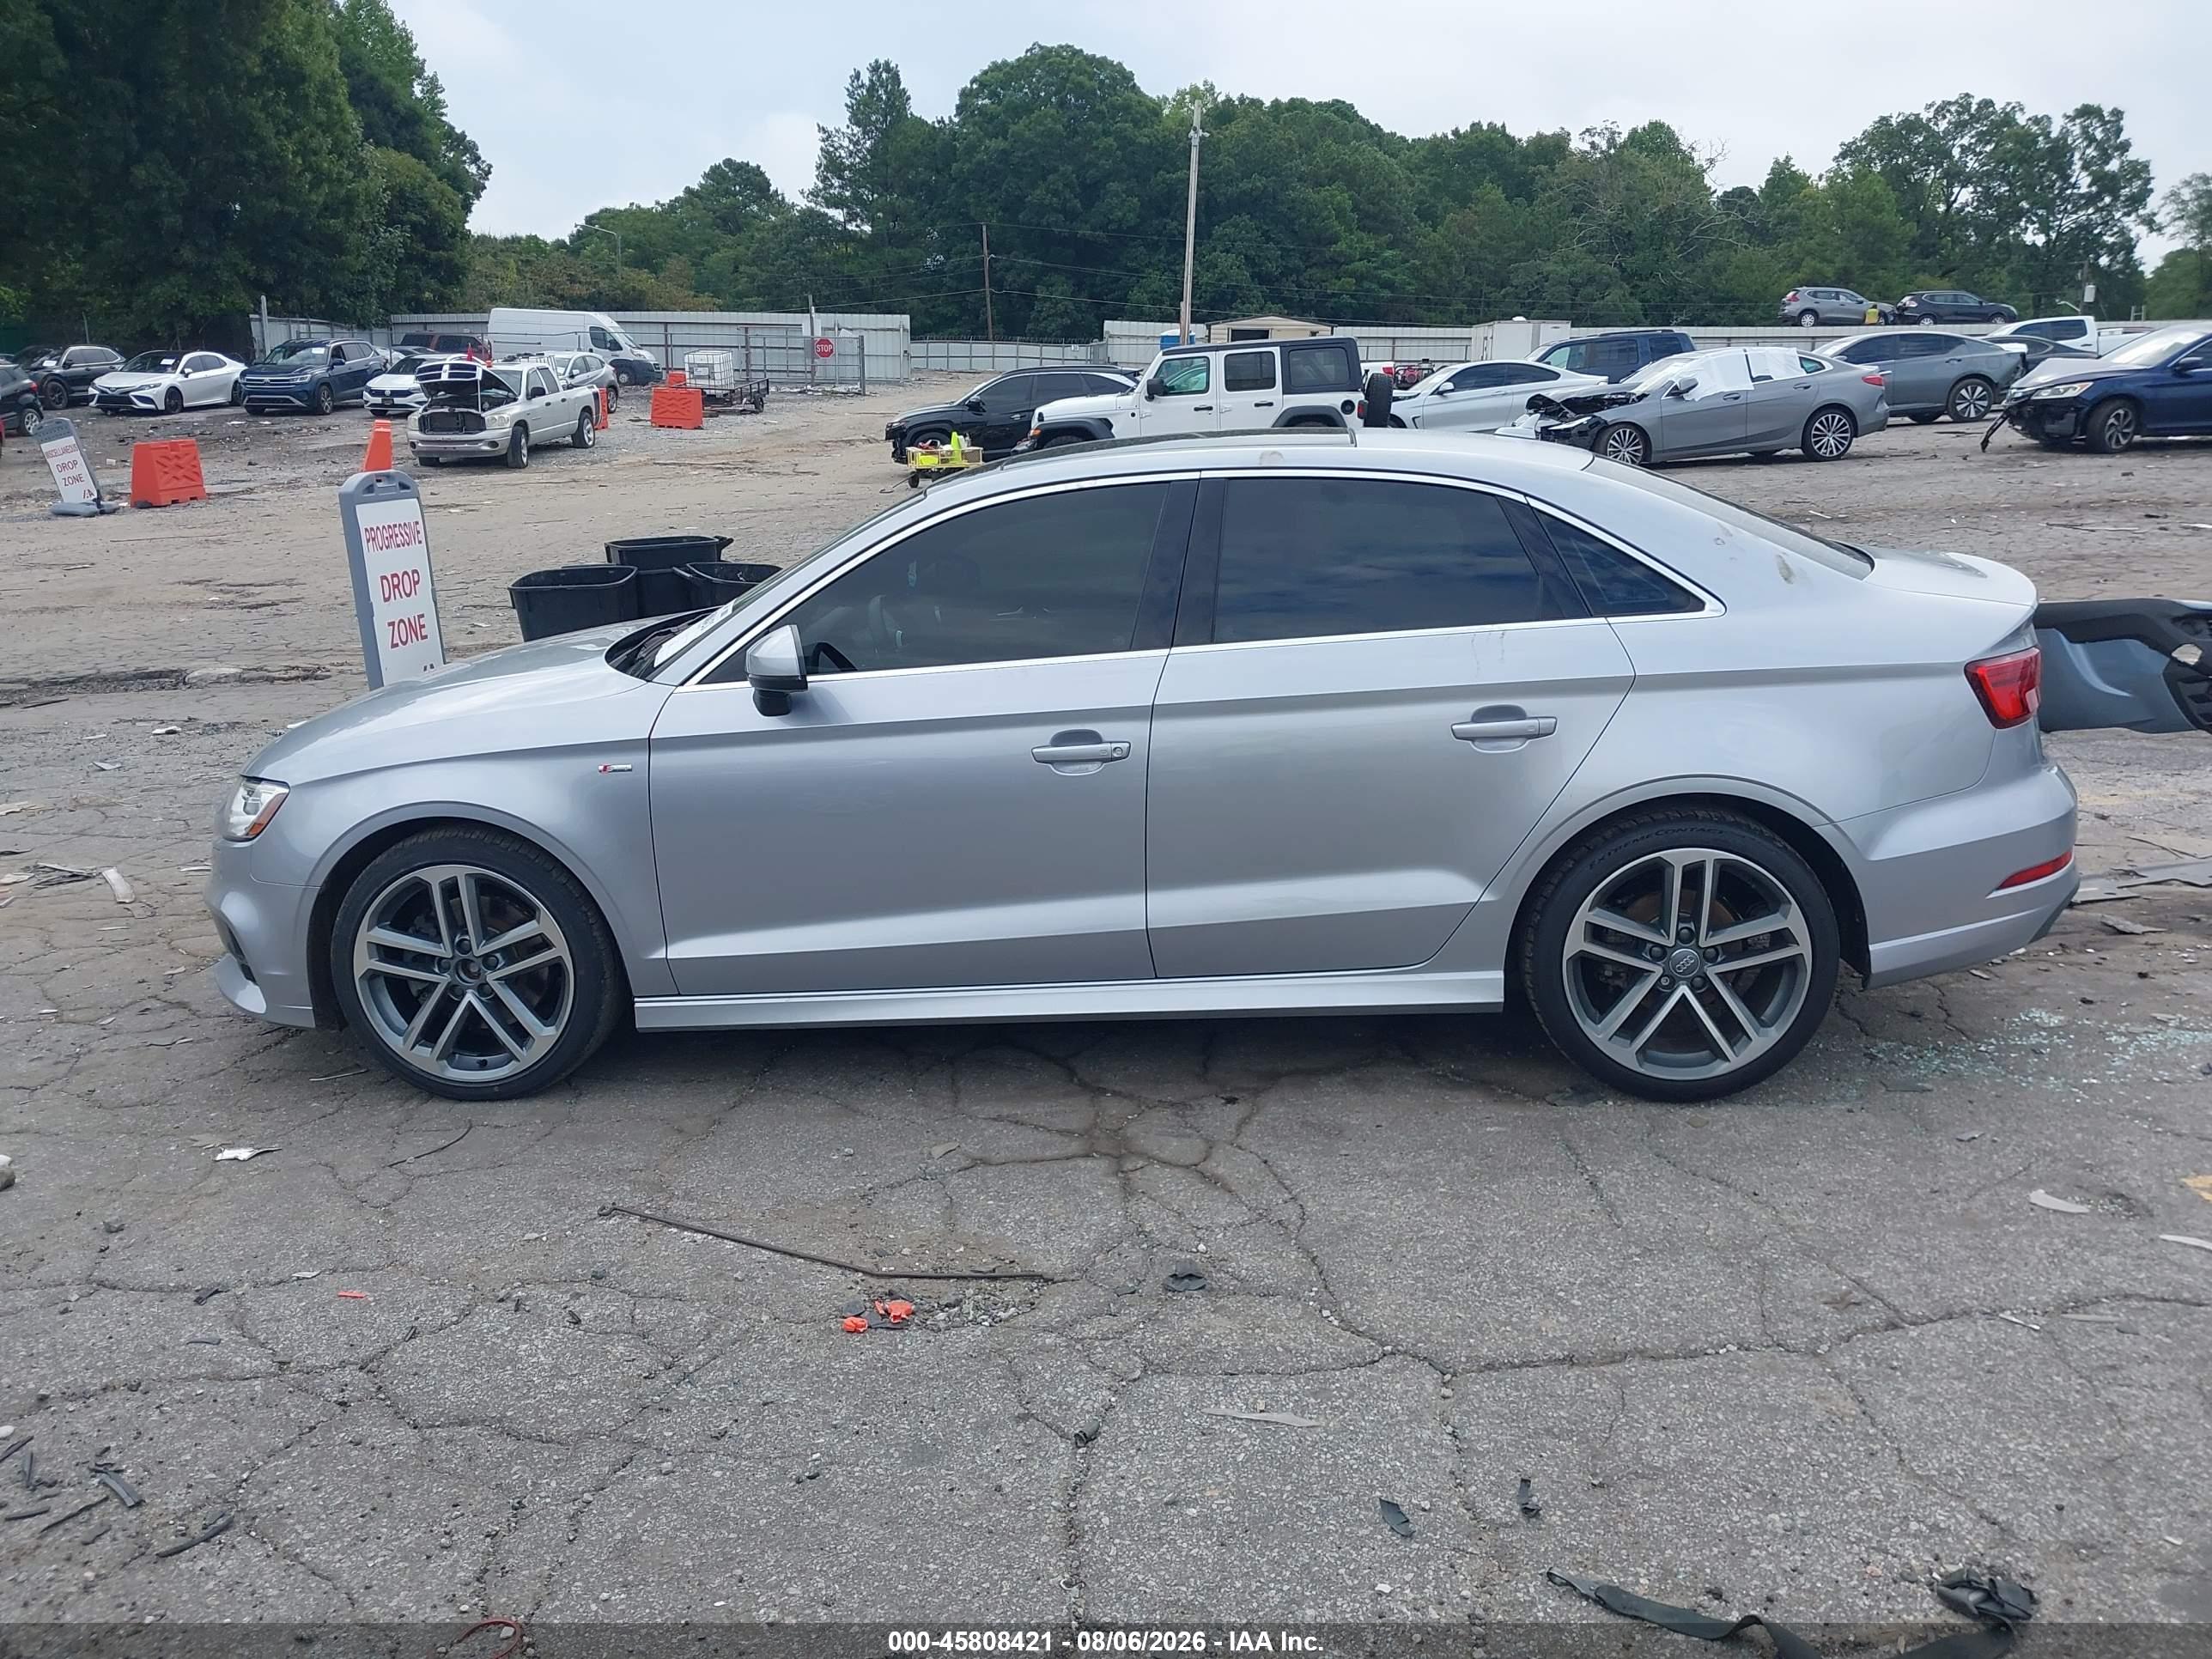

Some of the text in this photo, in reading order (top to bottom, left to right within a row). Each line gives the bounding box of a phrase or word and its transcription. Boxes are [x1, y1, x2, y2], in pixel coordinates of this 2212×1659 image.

[816, 343, 833, 353] STOP
[56, 459, 78, 473] DROP
[62, 473, 85, 487] ZONE
[364, 520, 422, 553] PROGRESSIVE
[380, 568, 421, 603] DROP
[387, 613, 428, 649] ZONE
